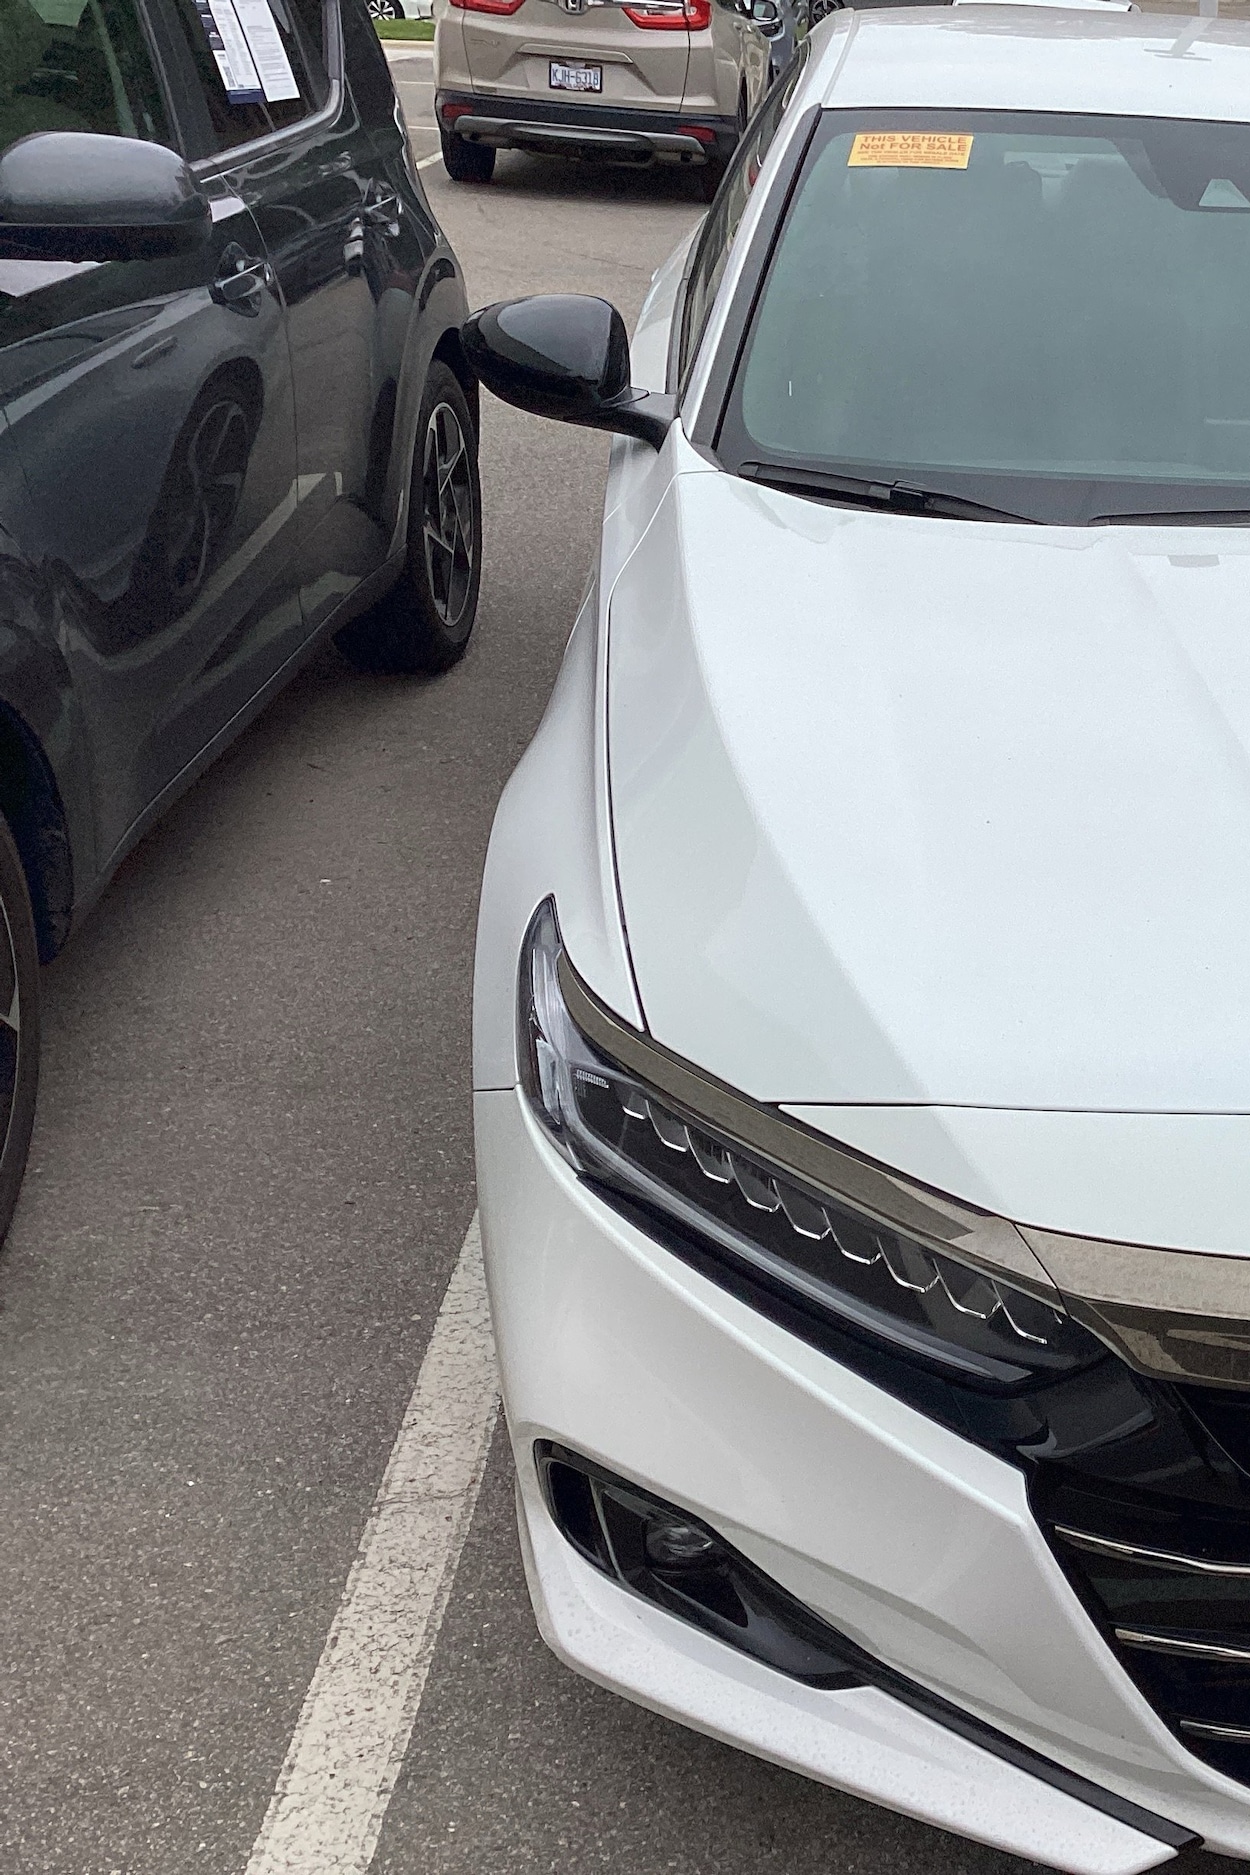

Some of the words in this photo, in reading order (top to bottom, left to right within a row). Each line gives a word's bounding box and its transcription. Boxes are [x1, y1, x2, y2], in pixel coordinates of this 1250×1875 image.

[863, 135, 896, 143] THIS
[901, 135, 967, 144] VEHICLE
[860, 142, 885, 150] Not
[889, 142, 922, 150] FOR
[926, 143, 967, 151] SALE
